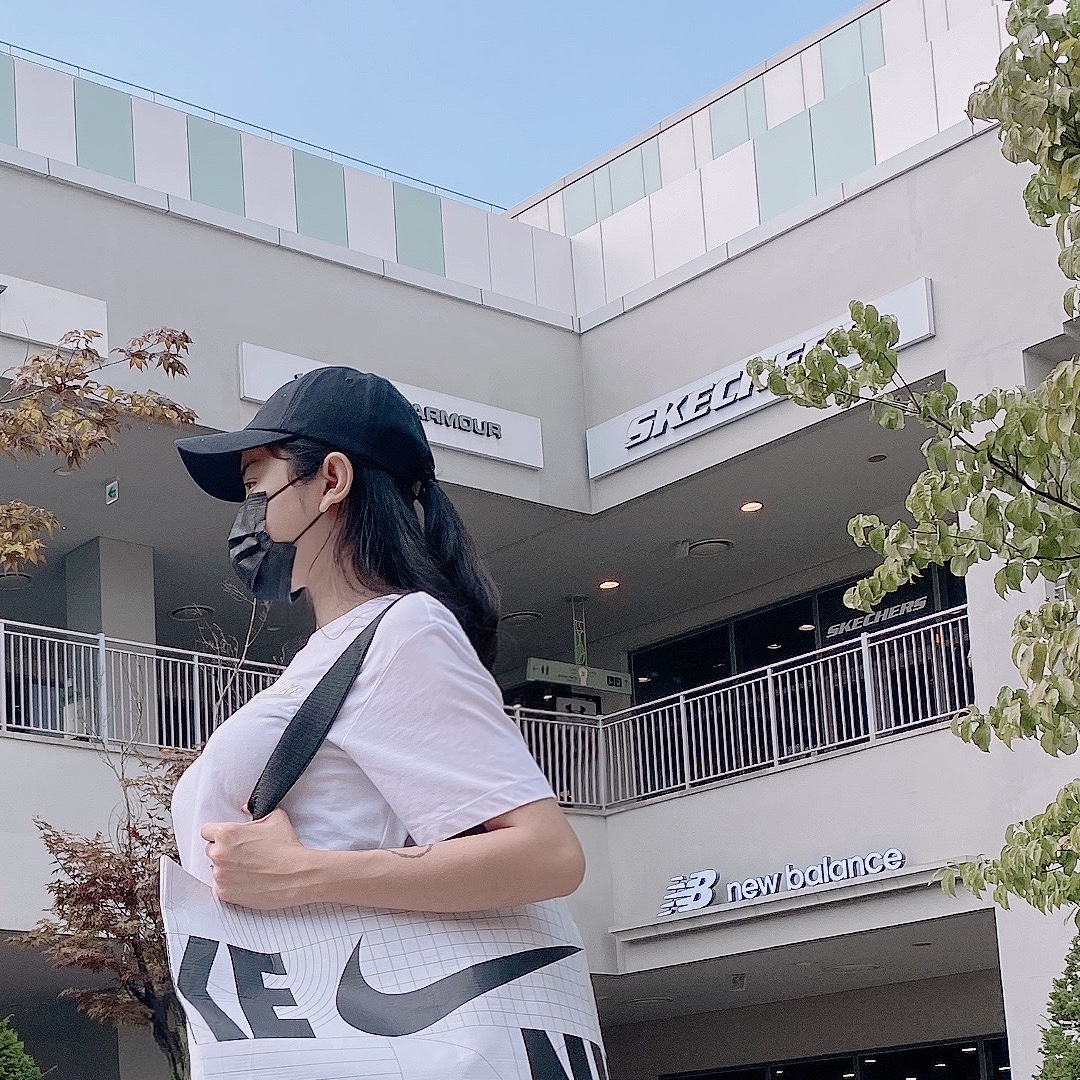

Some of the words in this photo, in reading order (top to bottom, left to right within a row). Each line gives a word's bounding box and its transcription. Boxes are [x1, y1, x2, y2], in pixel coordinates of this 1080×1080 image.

[413, 403, 502, 439] ARMOUR
[826, 596, 928, 638] SKECHERS
[726, 872, 782, 902] new
[785, 847, 907, 891] balance
